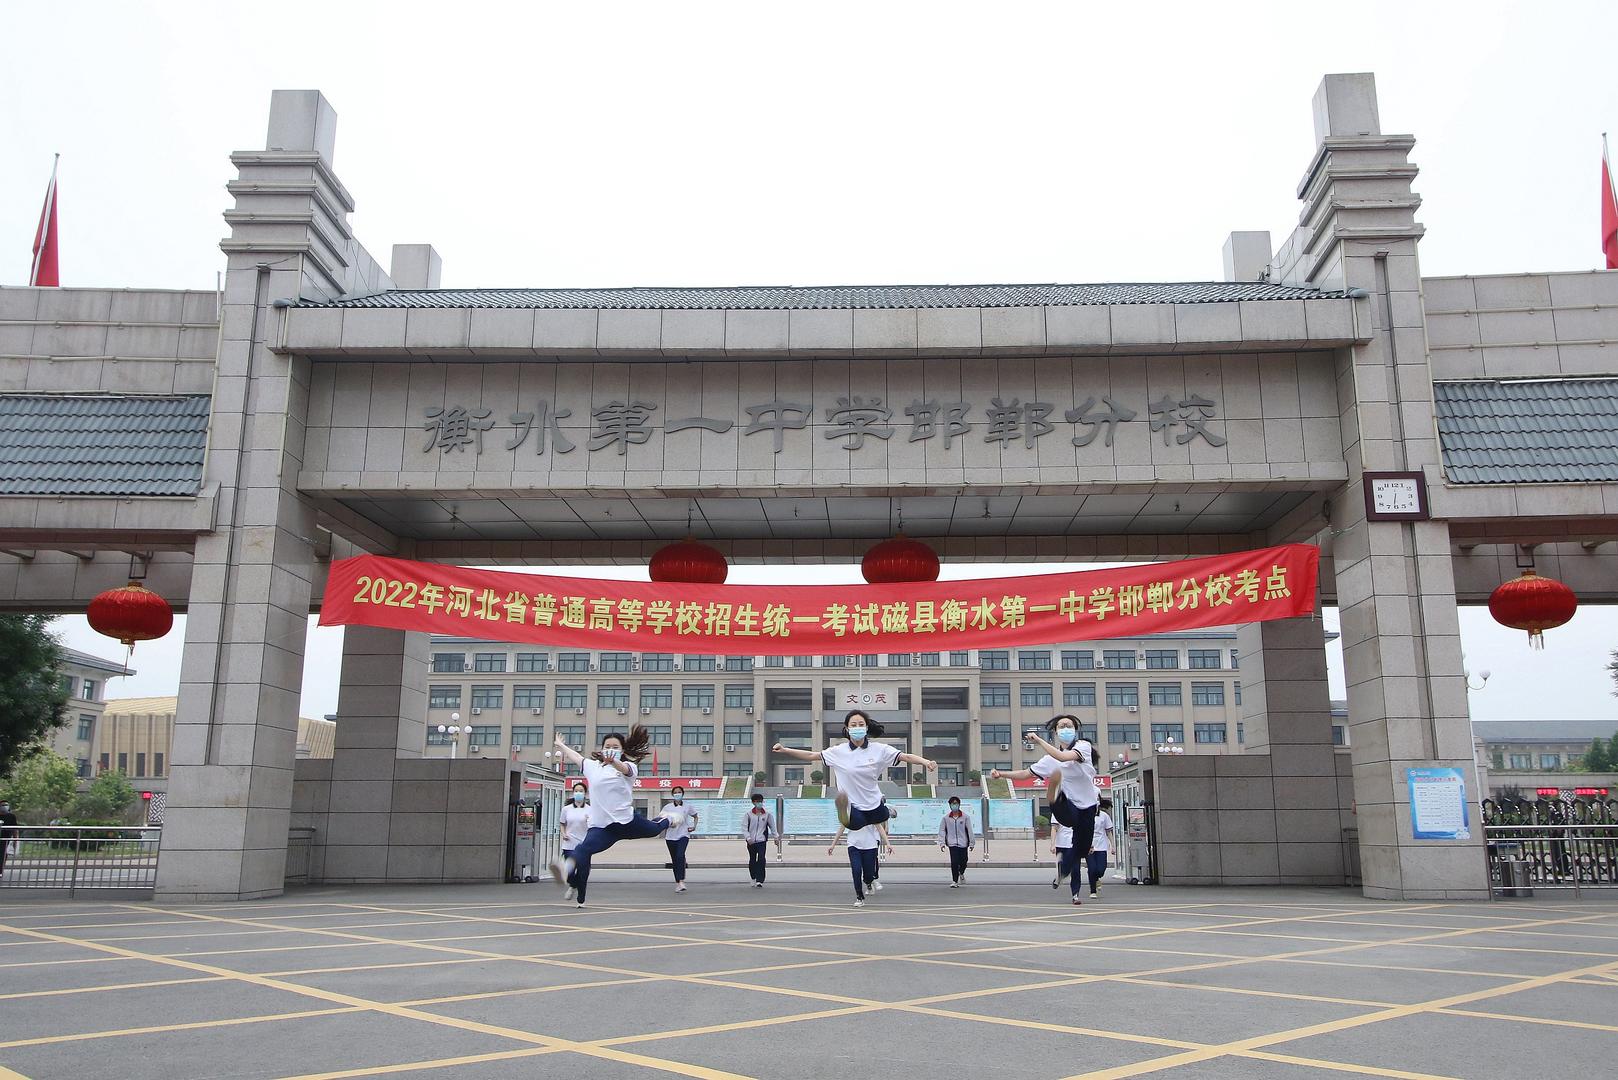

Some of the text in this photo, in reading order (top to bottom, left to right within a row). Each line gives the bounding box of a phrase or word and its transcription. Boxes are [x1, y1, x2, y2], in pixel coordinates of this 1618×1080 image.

[424, 394, 1227, 455] 衡水第一中学邯郸分校
[353, 564, 1291, 637] 2022年河北省普通高等学校招生统一考试磁县衡水第一中学邯郸分校考点
[846, 694, 858, 704] 文
